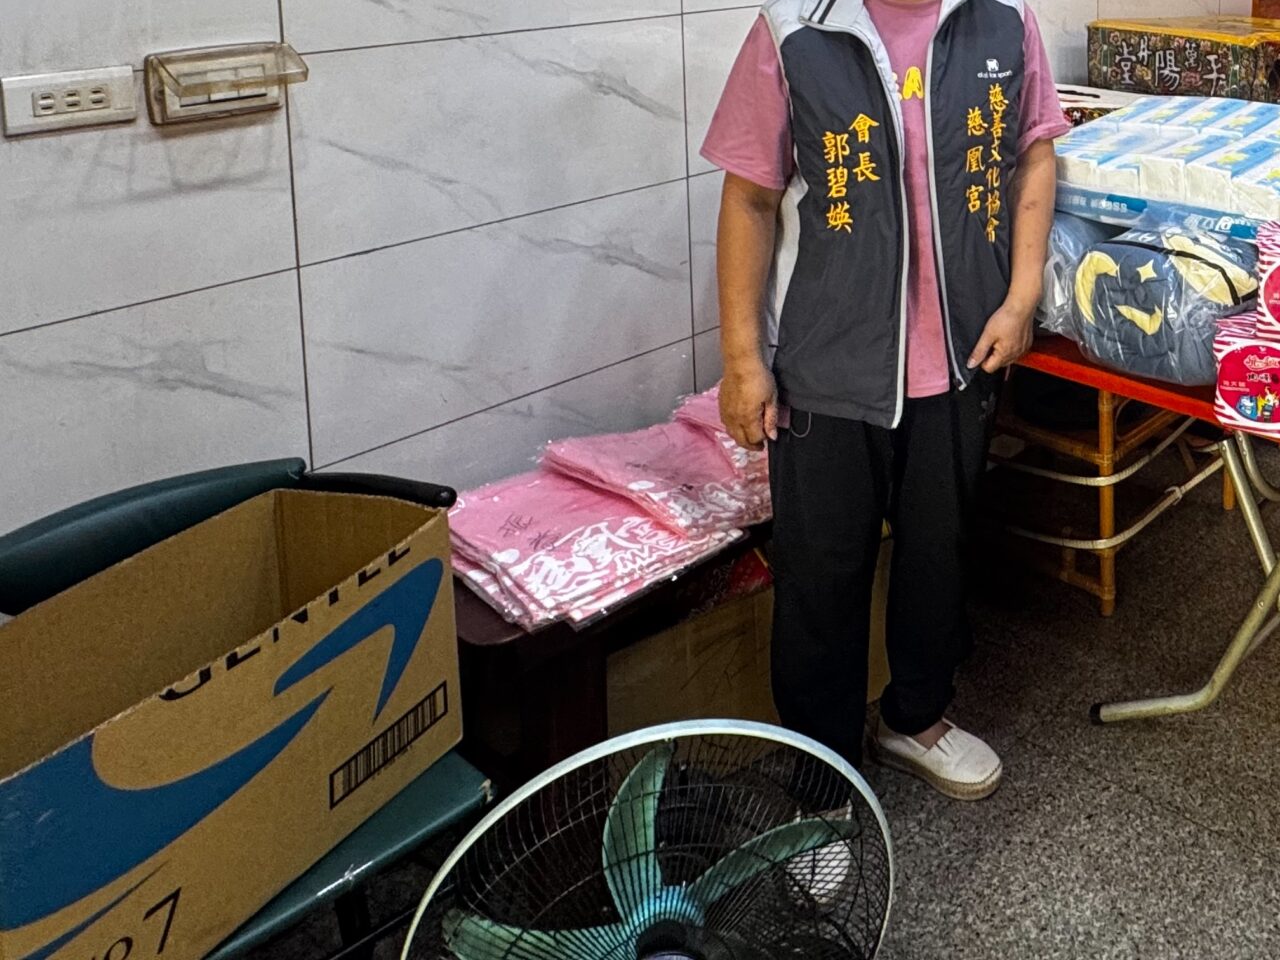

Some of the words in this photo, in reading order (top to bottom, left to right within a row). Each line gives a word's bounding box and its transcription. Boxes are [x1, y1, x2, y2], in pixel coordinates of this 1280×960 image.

[848, 113, 880, 182] 會長
[966, 106, 988, 214] 慈凰宮
